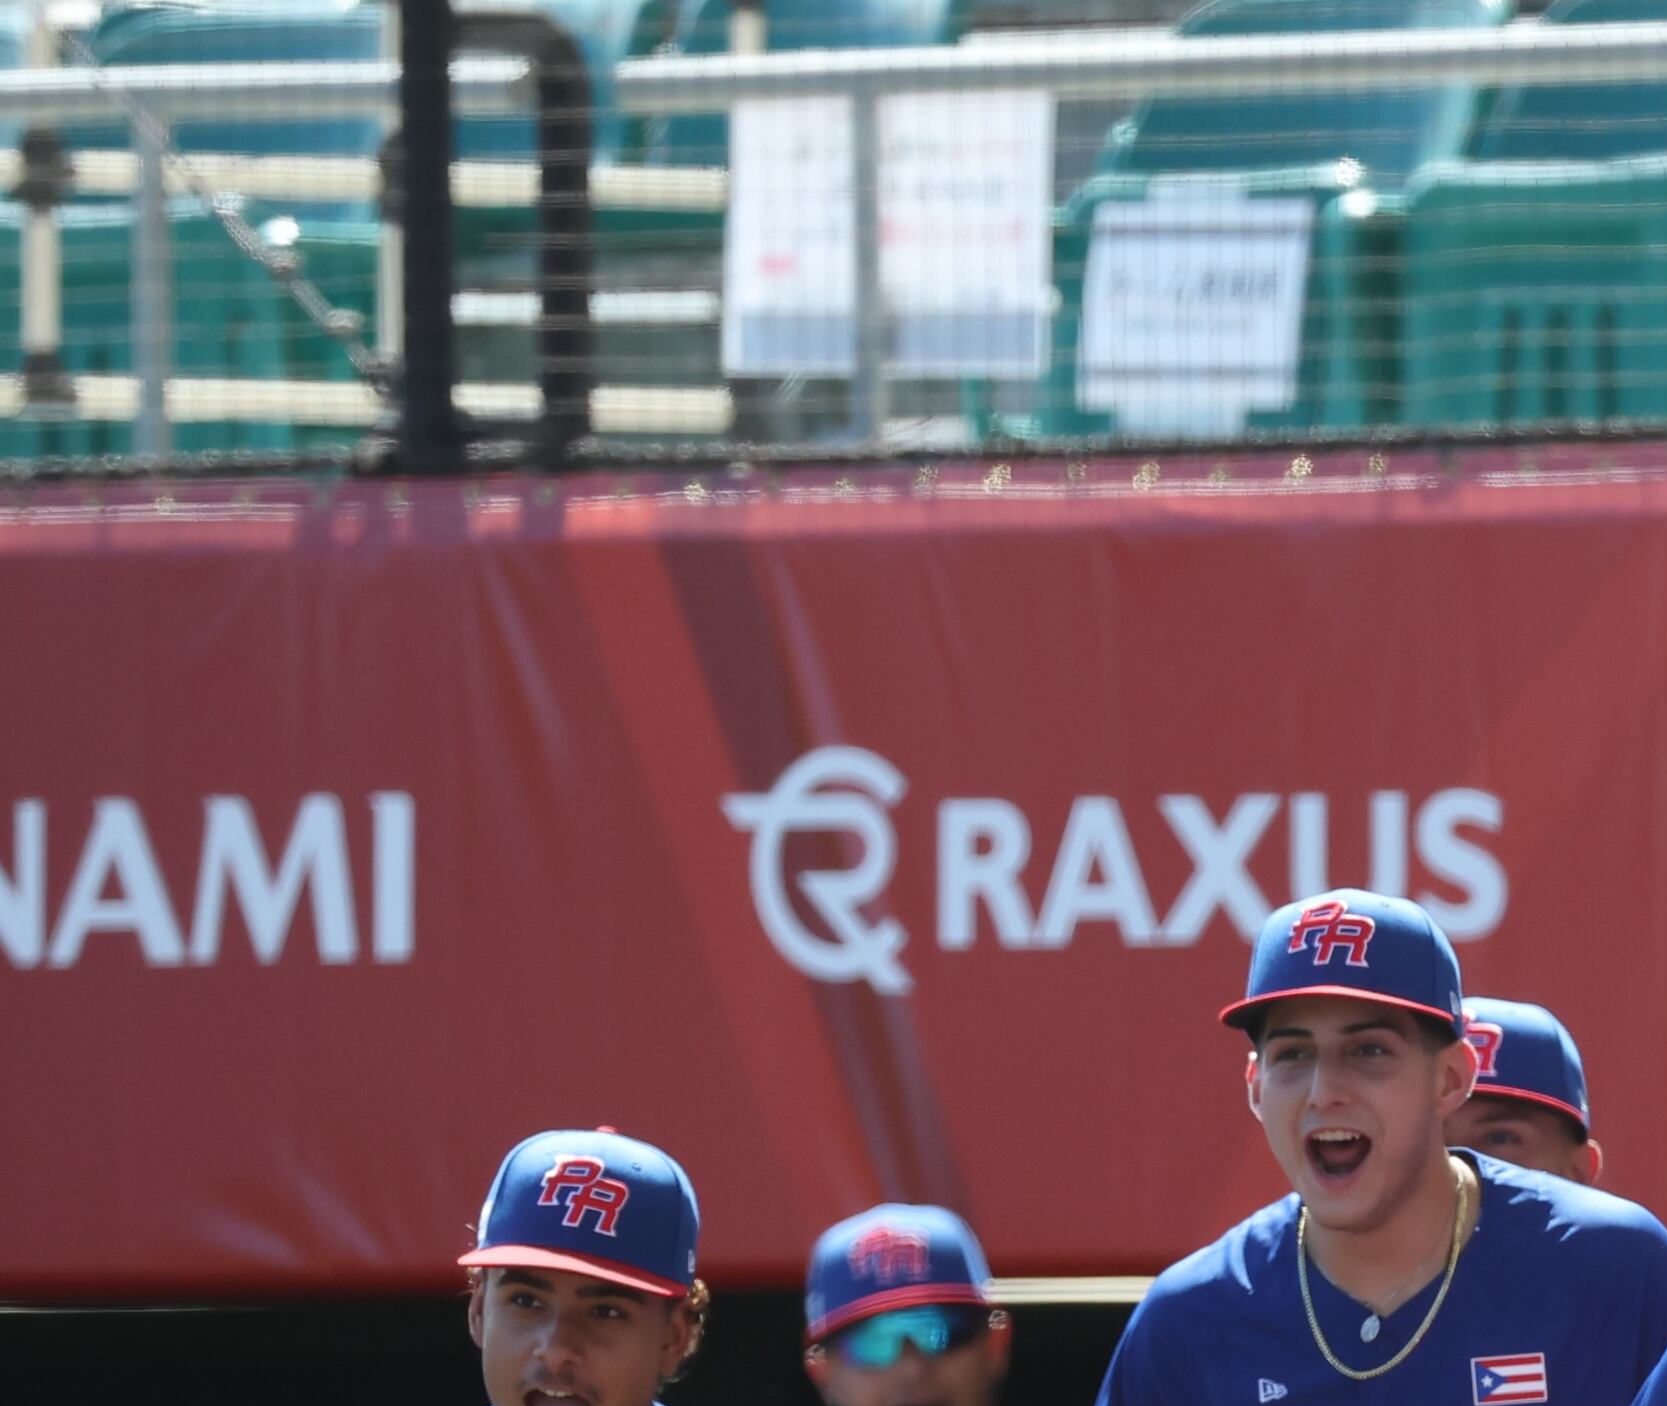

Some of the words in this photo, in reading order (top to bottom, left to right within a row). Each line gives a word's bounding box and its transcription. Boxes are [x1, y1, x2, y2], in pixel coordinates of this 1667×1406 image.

[937, 788, 1510, 950] RAXUS
[1288, 900, 1376, 968] PR
[537, 1153, 630, 1238] PR
